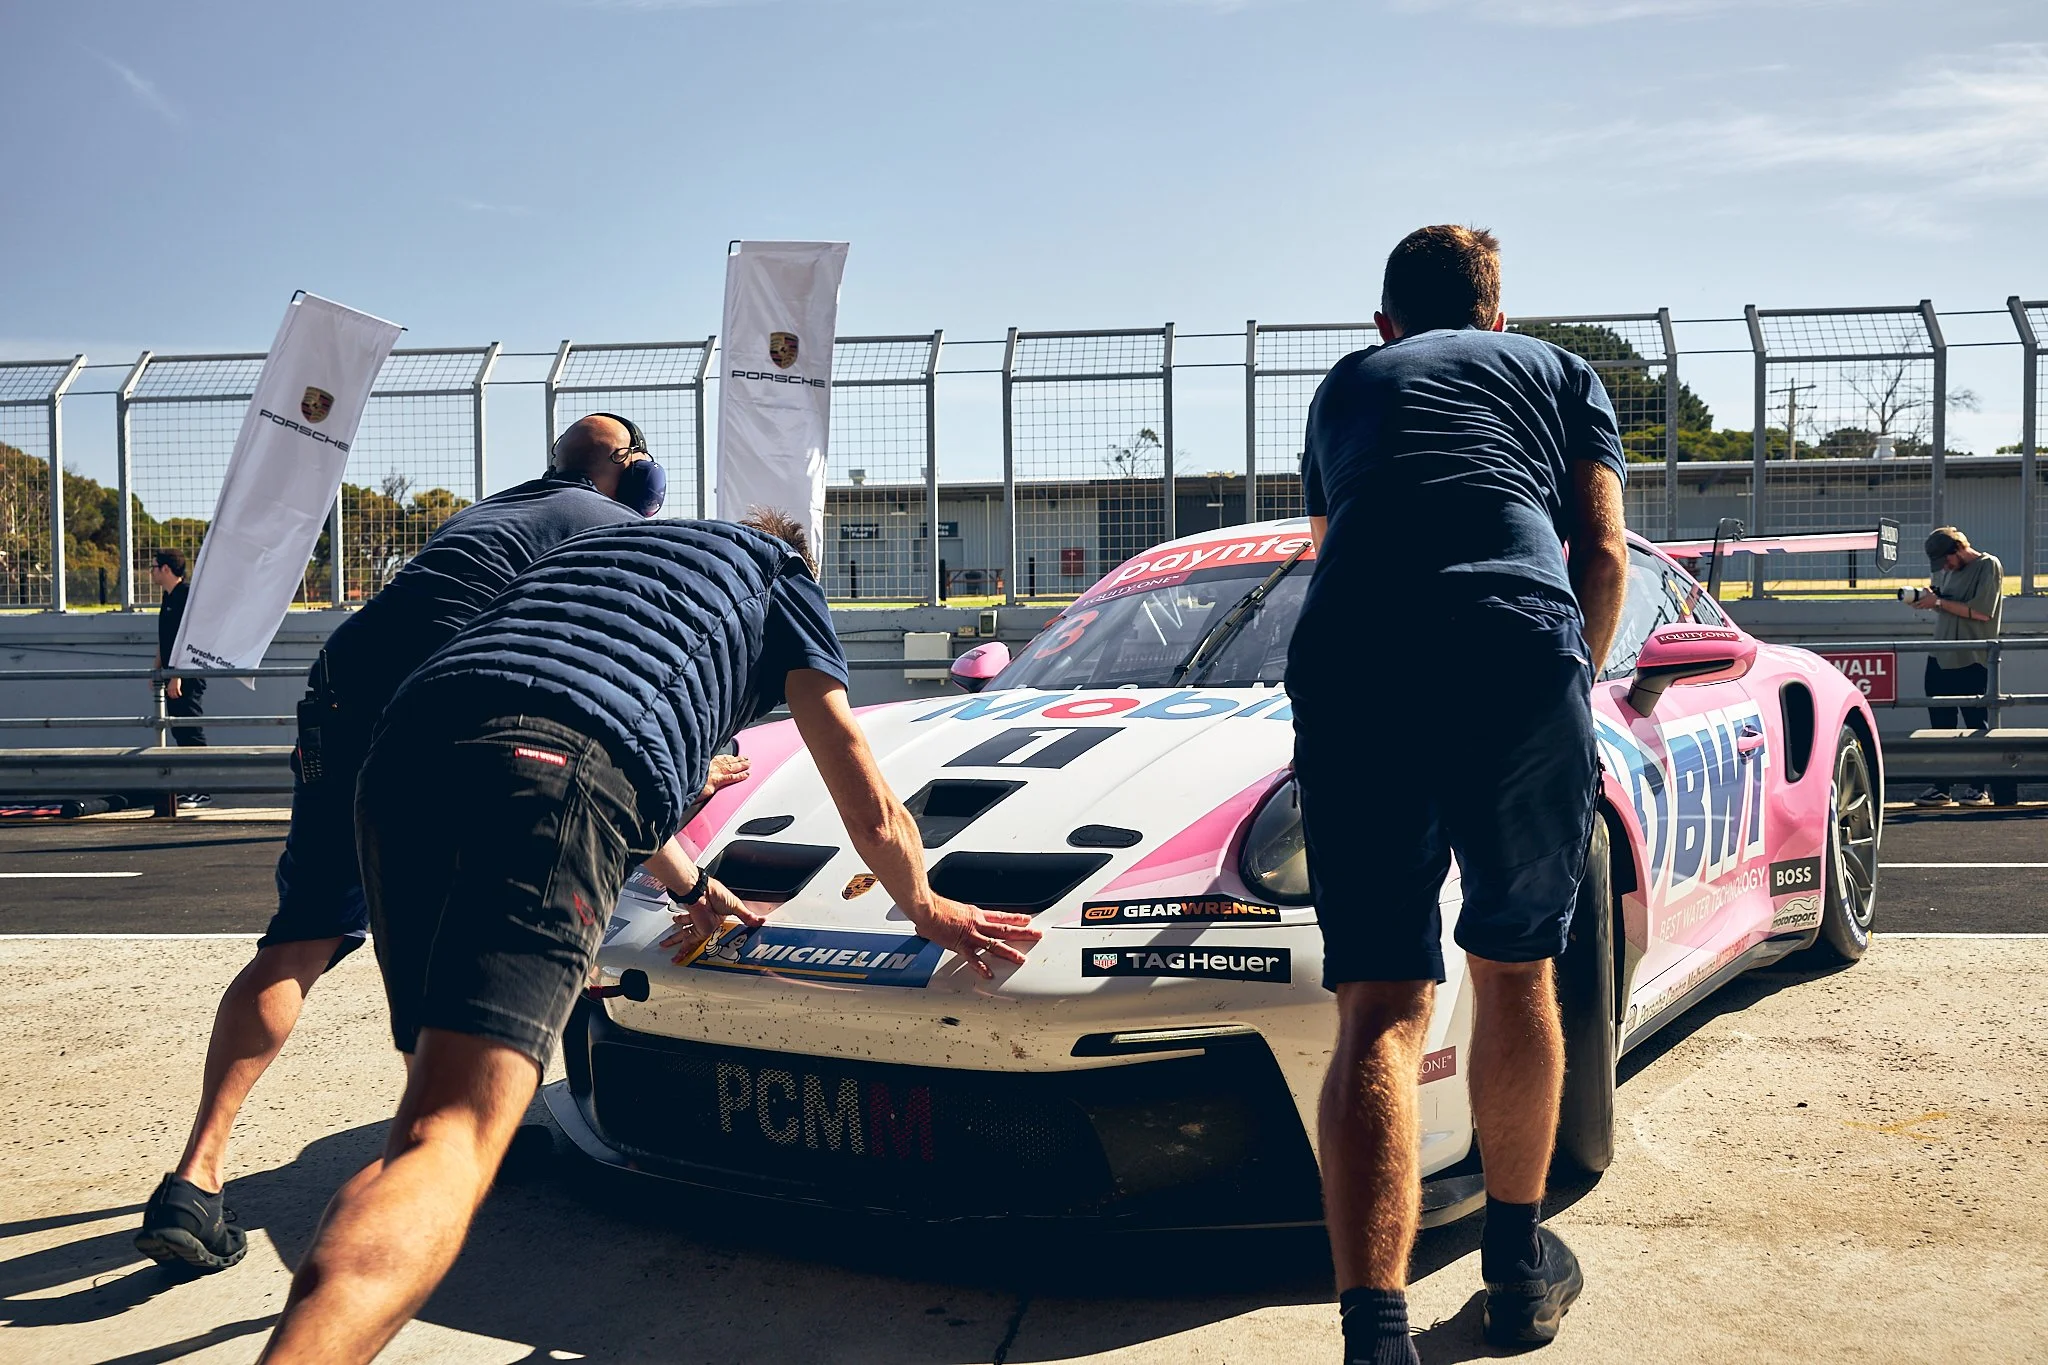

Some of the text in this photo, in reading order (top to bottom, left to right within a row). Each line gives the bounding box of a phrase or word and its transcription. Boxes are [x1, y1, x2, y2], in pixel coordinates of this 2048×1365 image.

[732, 370, 825, 388] PORSCHE
[260, 409, 349, 453] PORSCHE
[1106, 535, 1316, 589] paynte
[186, 644, 216, 662] Porsche
[996, 728, 1079, 765] 1
[1776, 866, 1812, 887] BOSS
[1124, 902, 1277, 917] GEARWRENCH
[1659, 866, 1766, 944] BEST WATER TECHNOLOGY
[1773, 912, 1818, 928] motorsport
[746, 944, 917, 970] MICHELIN
[716, 1062, 935, 1163] PCMM
